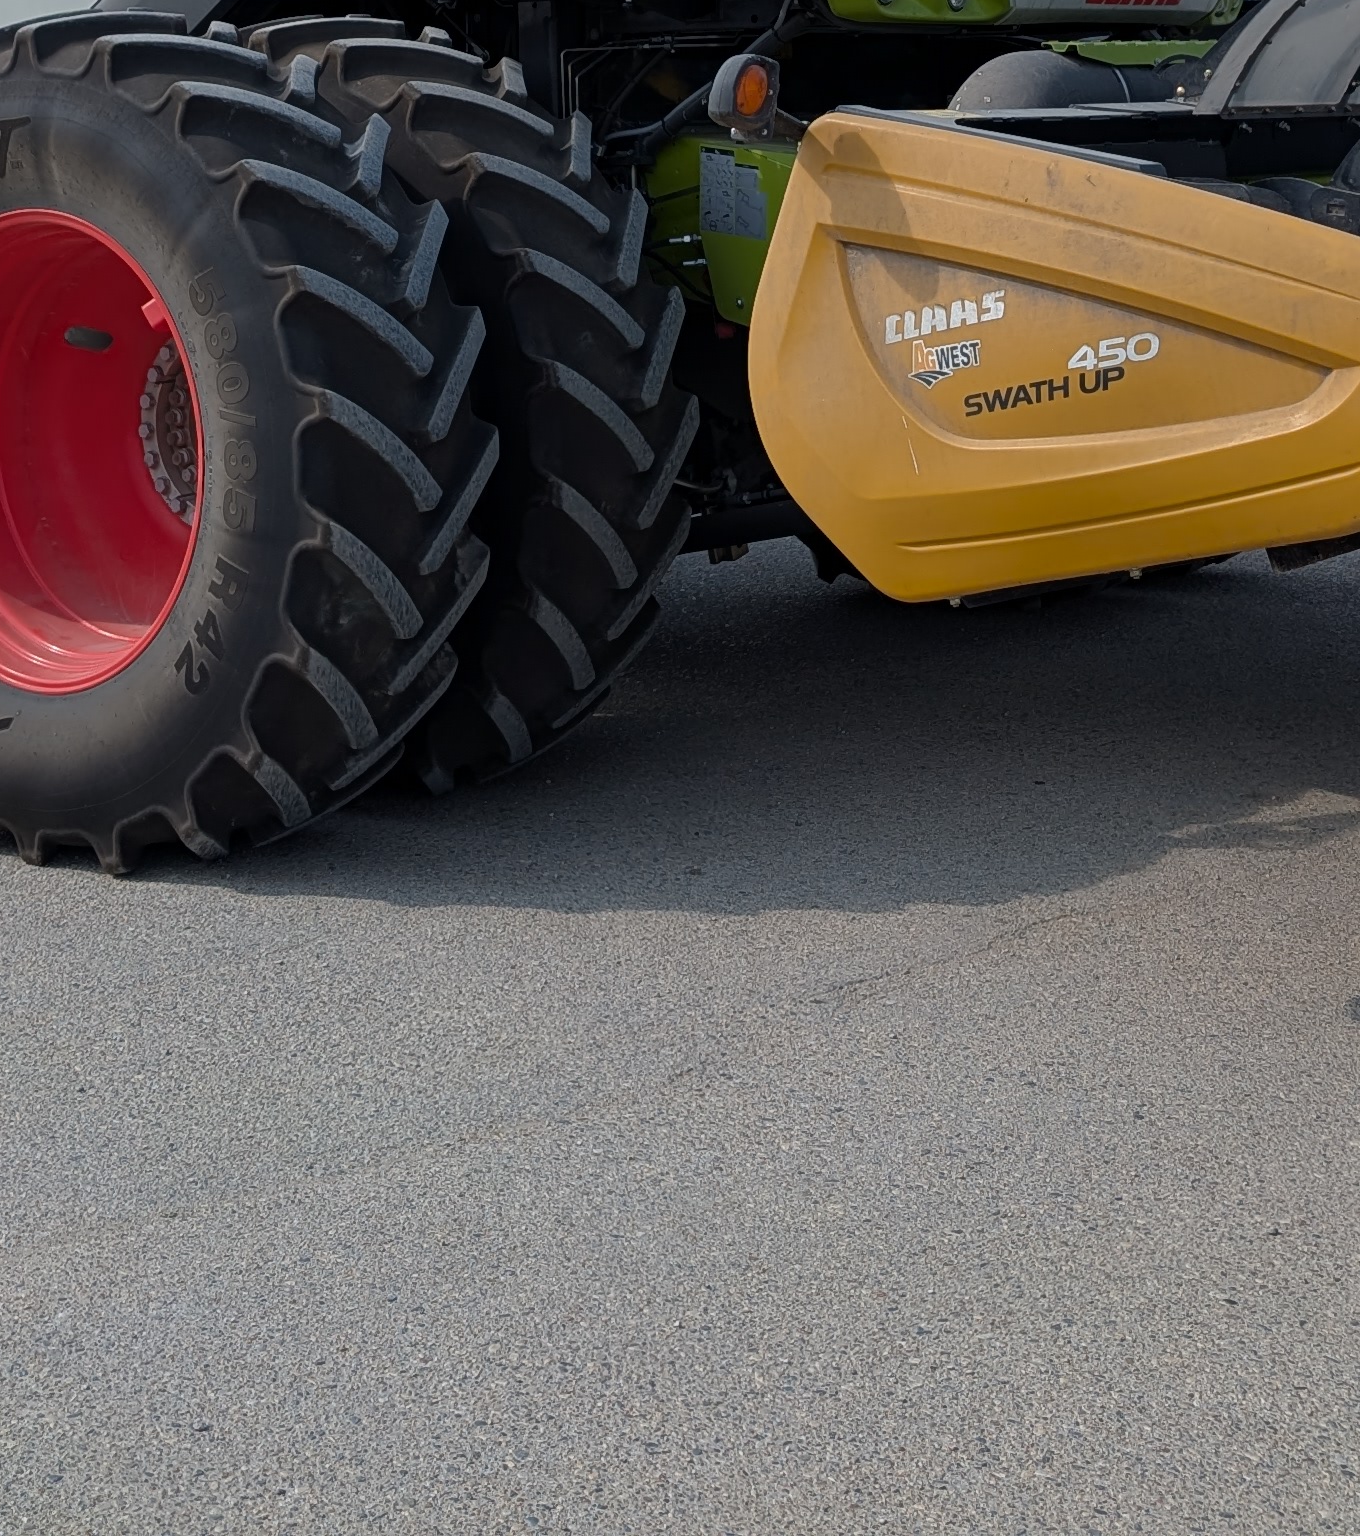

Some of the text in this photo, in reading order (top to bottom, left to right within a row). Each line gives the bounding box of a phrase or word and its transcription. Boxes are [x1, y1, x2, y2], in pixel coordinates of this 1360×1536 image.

[885, 289, 1006, 345] CLAAS
[1067, 332, 1160, 371] 450
[188, 265, 259, 533] 580/85
[964, 366, 1125, 417] SWATH UP
